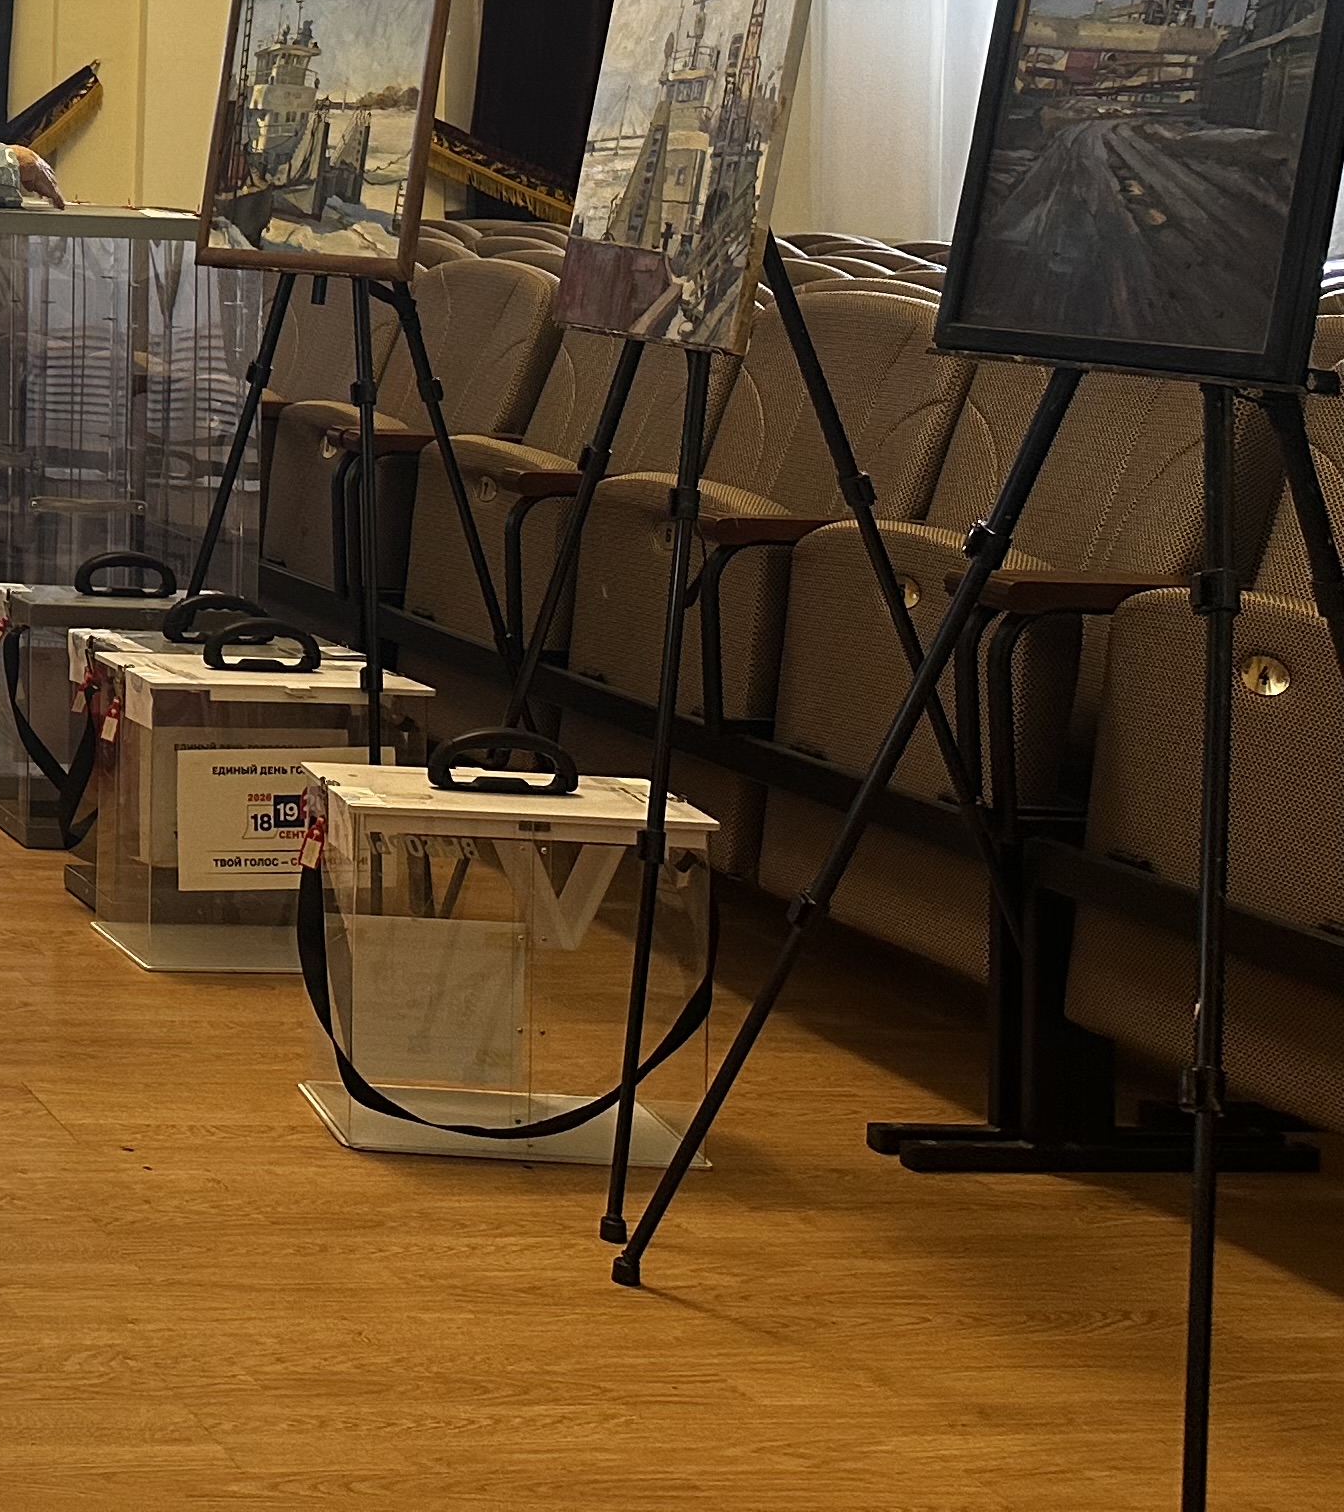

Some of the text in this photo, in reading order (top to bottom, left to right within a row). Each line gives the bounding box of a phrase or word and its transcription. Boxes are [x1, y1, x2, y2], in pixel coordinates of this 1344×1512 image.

[665, 527, 673, 543] 6
[1258, 665, 1271, 686] 4
[212, 764, 258, 776] ЕДИНЫЙ
[260, 766, 288, 776] ДЕНЬ
[247, 793, 272, 802] 2026
[250, 813, 273, 832] 18
[276, 802, 299, 822] 19
[213, 857, 242, 868] ТВОЙ
[244, 858, 279, 867] ГОЛОС
